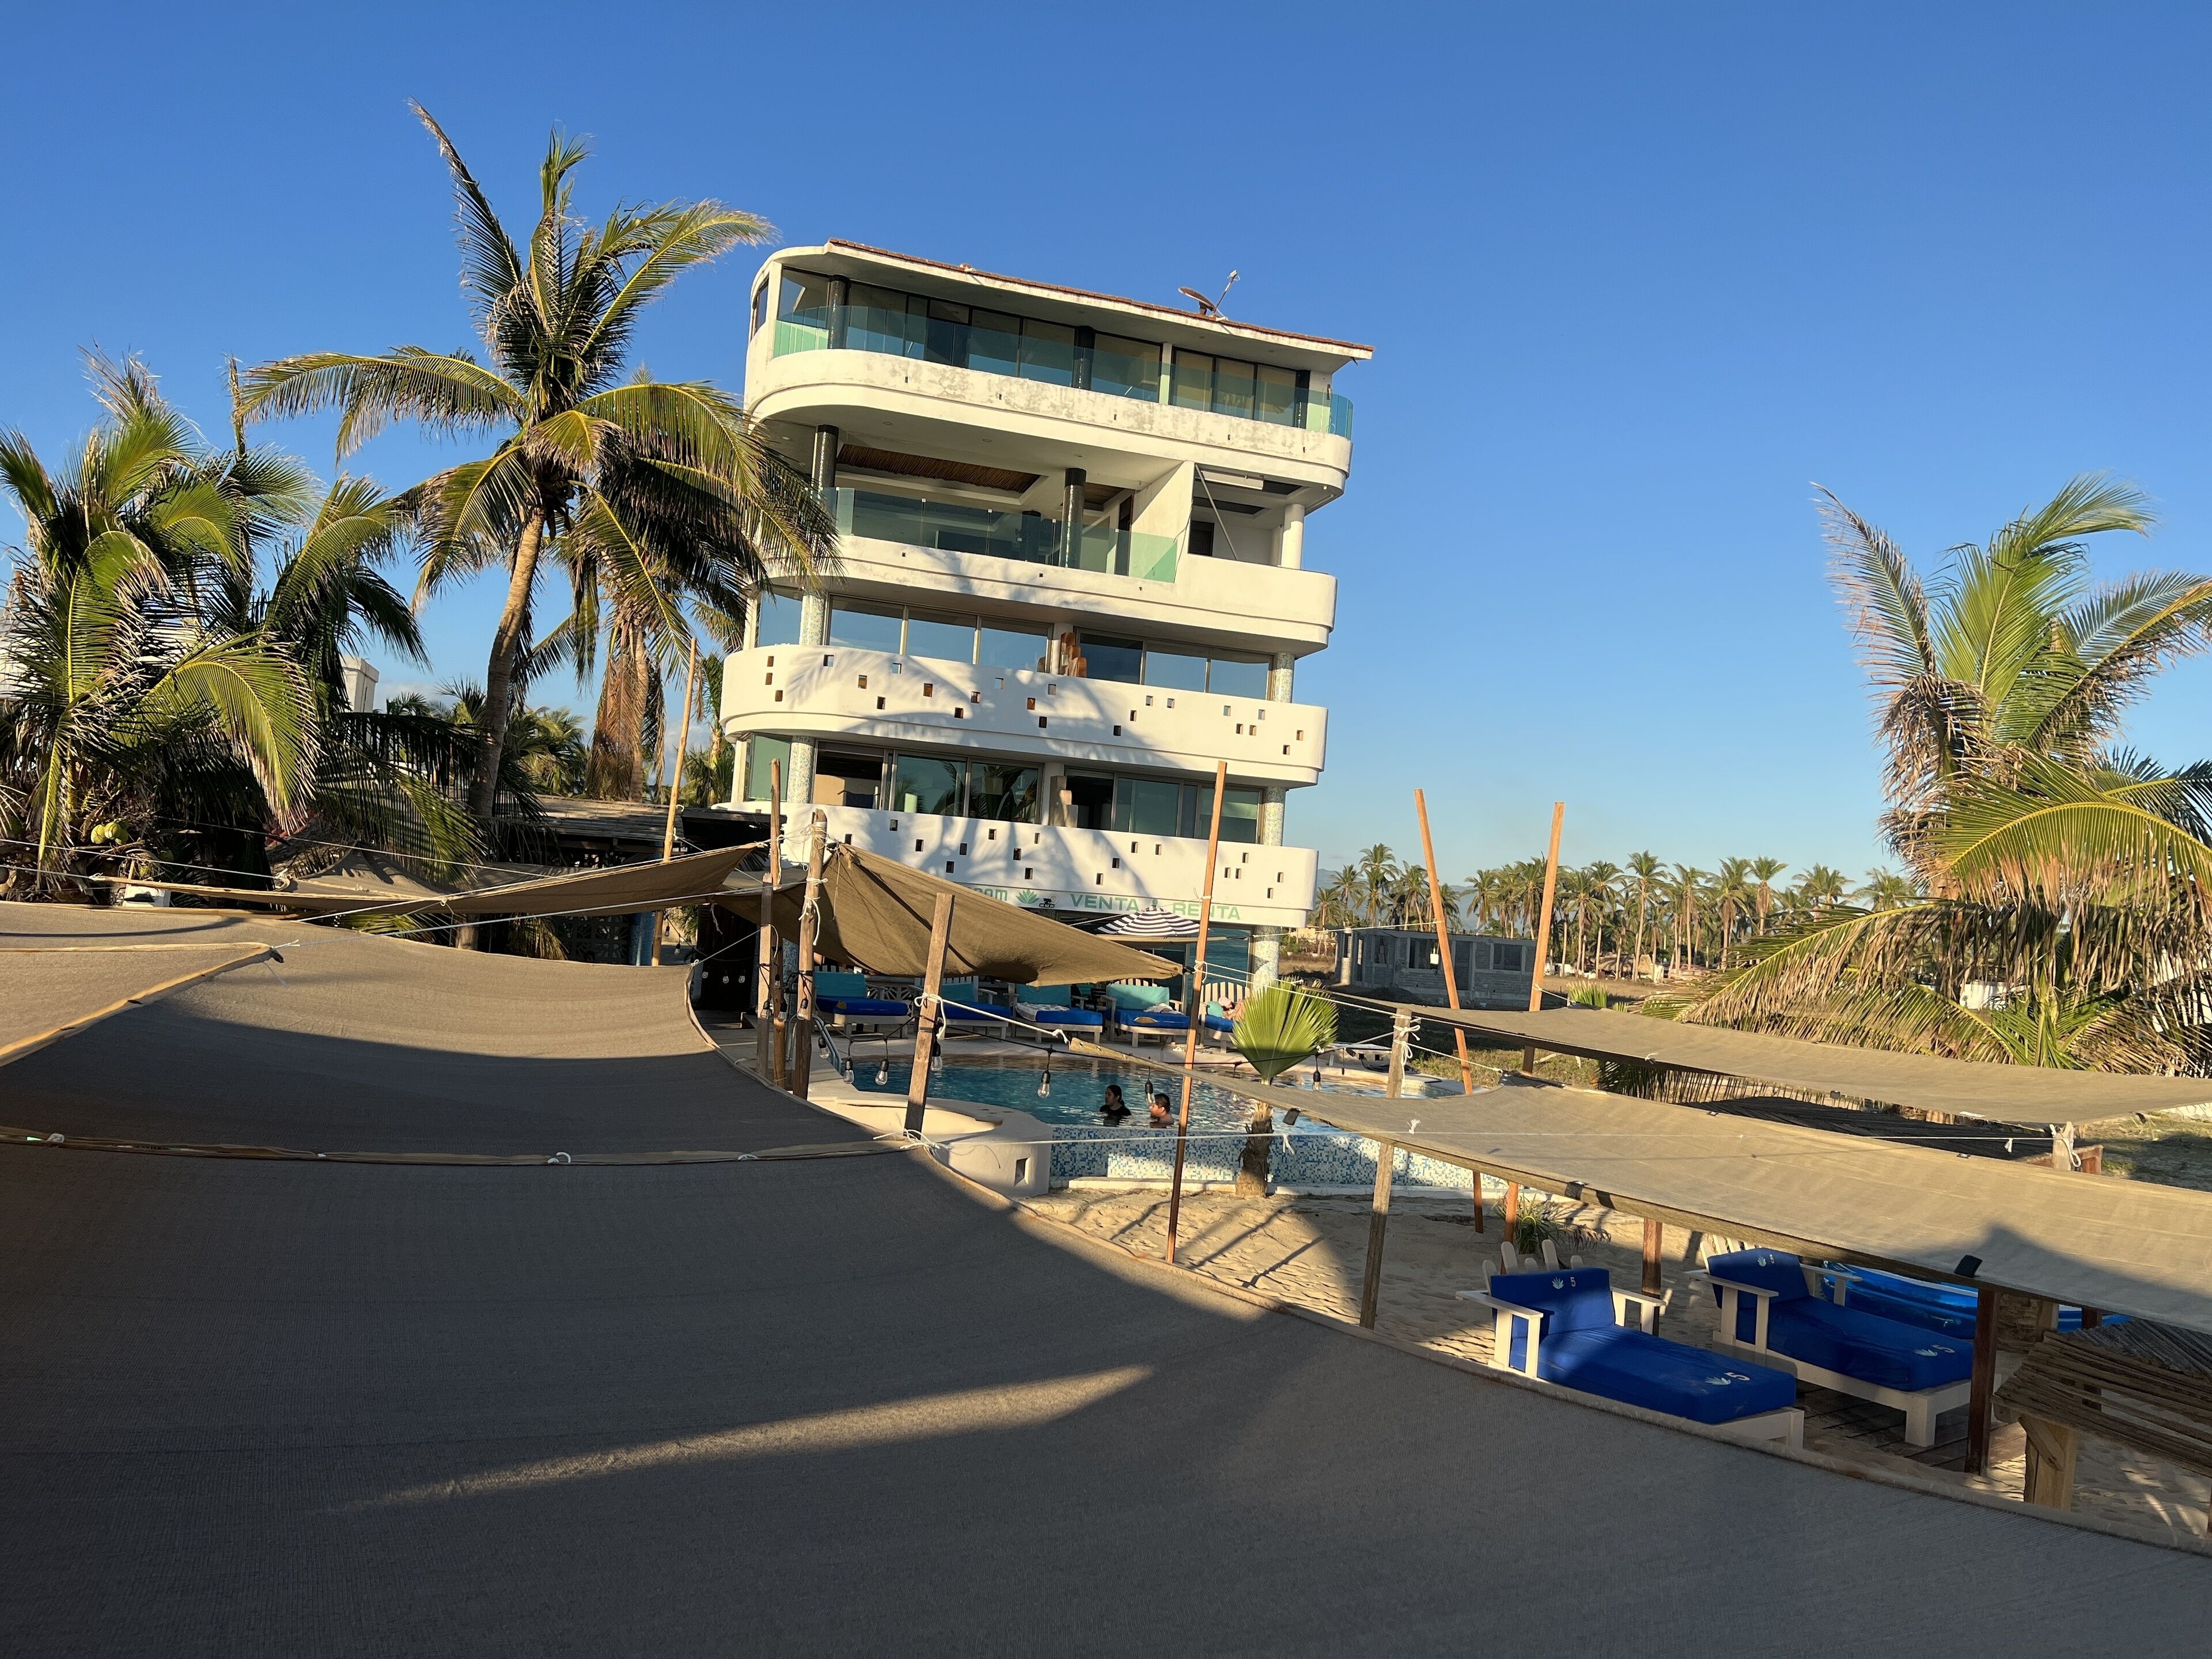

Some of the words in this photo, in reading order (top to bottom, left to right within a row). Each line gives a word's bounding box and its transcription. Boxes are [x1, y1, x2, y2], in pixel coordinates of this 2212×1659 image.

[1070, 894, 1139, 912] VENTA
[1570, 1277, 1576, 1287] 5
[1931, 1344, 1955, 1353] 5
[1724, 1372, 1751, 1381] 5
